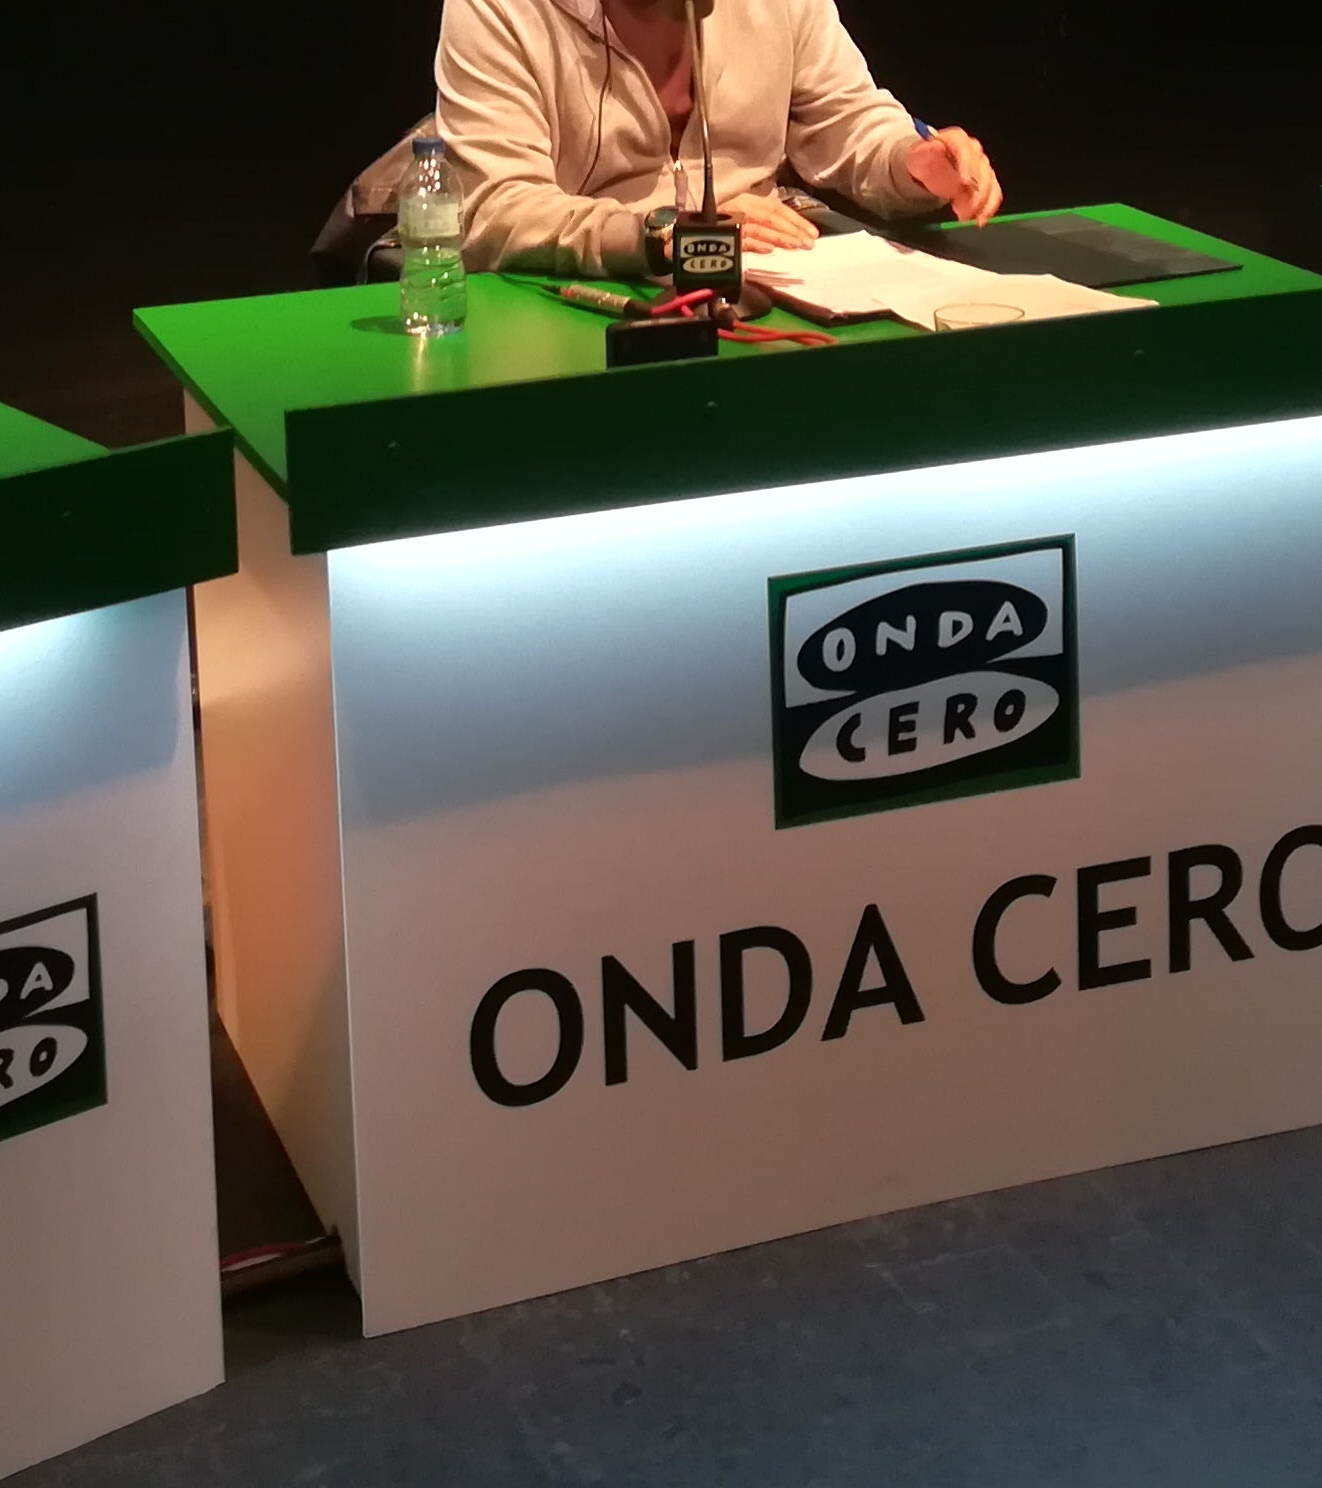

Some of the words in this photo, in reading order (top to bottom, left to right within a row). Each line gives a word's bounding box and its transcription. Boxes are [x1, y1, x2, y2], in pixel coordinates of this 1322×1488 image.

[687, 243, 727, 253] ONDA
[821, 600, 1024, 673] ONDA
[835, 688, 1027, 763] CERO
[469, 903, 925, 1108] ONDA
